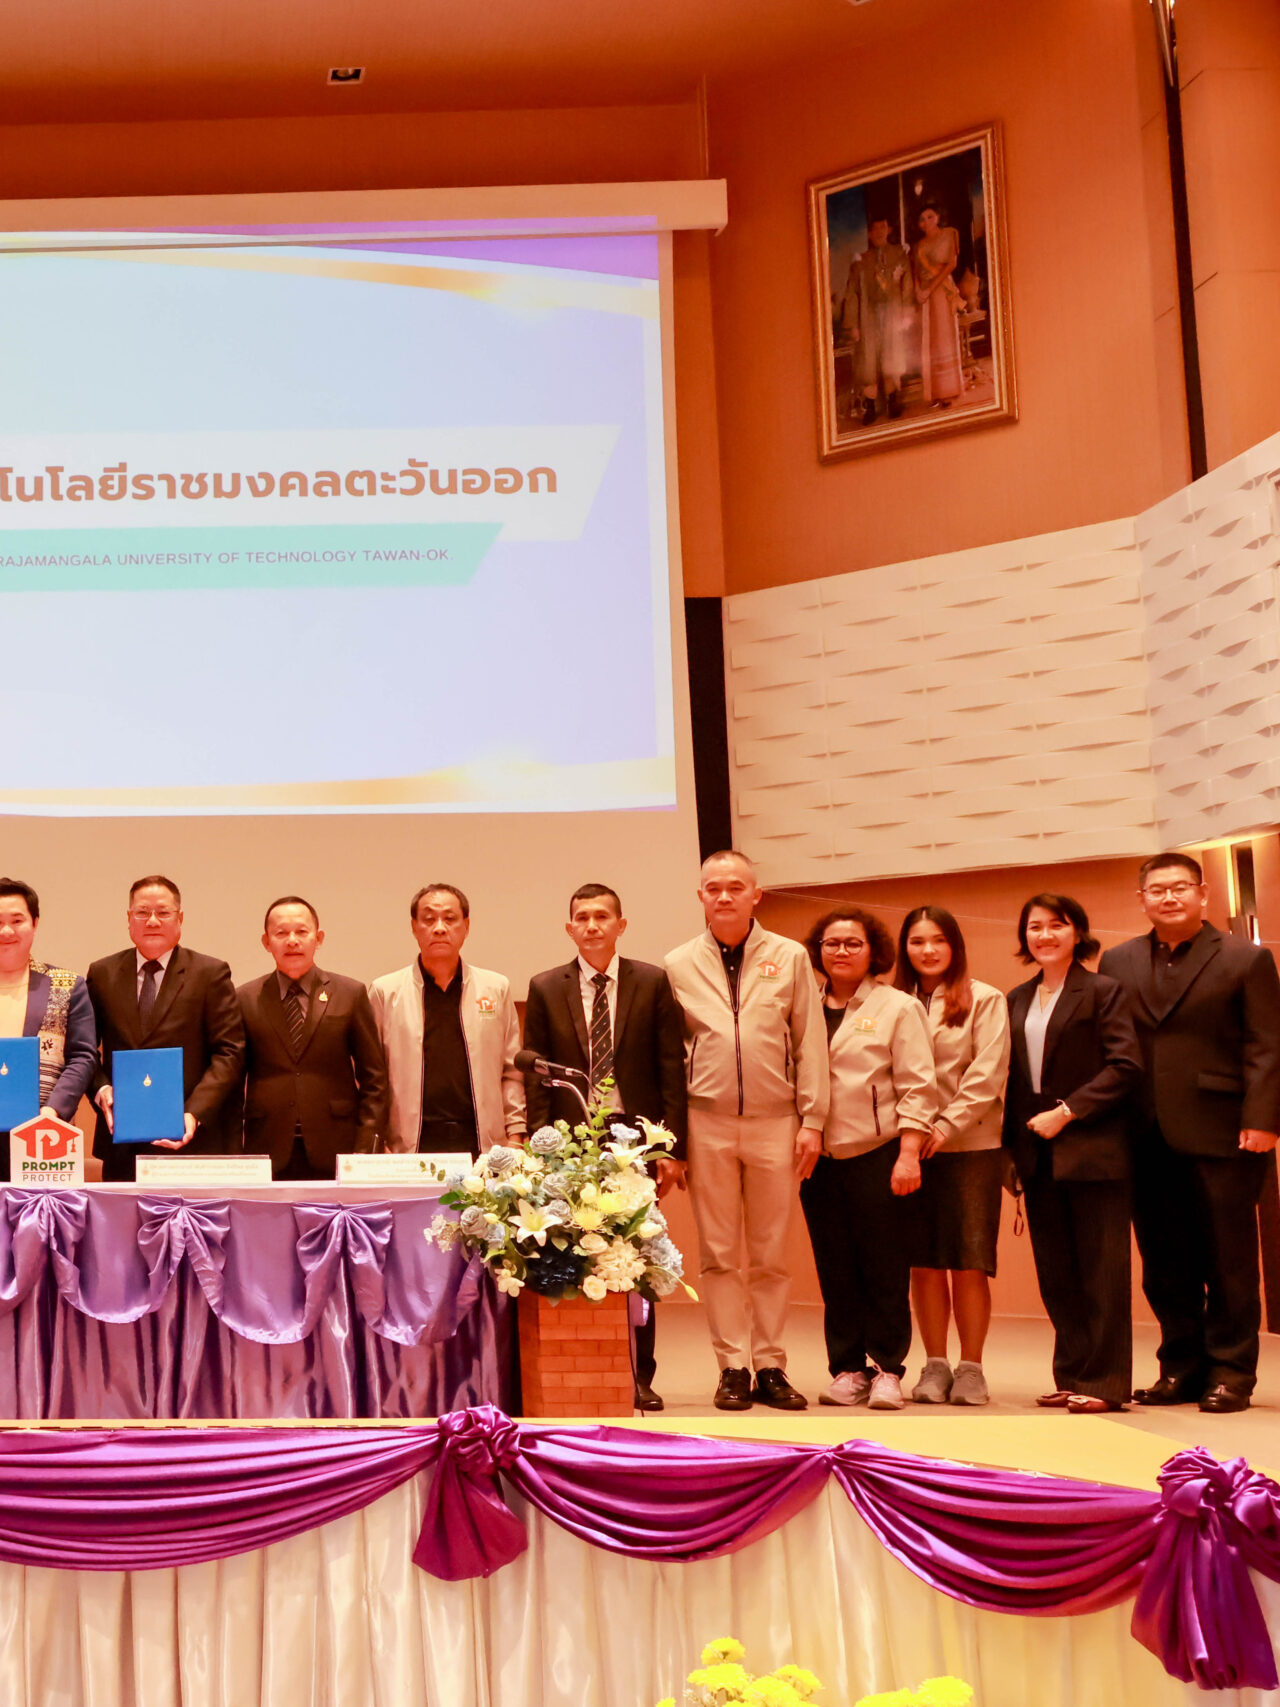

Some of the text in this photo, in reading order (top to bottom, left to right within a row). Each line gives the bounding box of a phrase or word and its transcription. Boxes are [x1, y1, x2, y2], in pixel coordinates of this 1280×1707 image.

[116, 552, 213, 566] UNIVERSITY
[217, 552, 240, 564] OF
[245, 550, 357, 563] TECHNOLOGY
[22, 1161, 75, 1171] PROMPT
[22, 1173, 73, 1182] PROTECT
